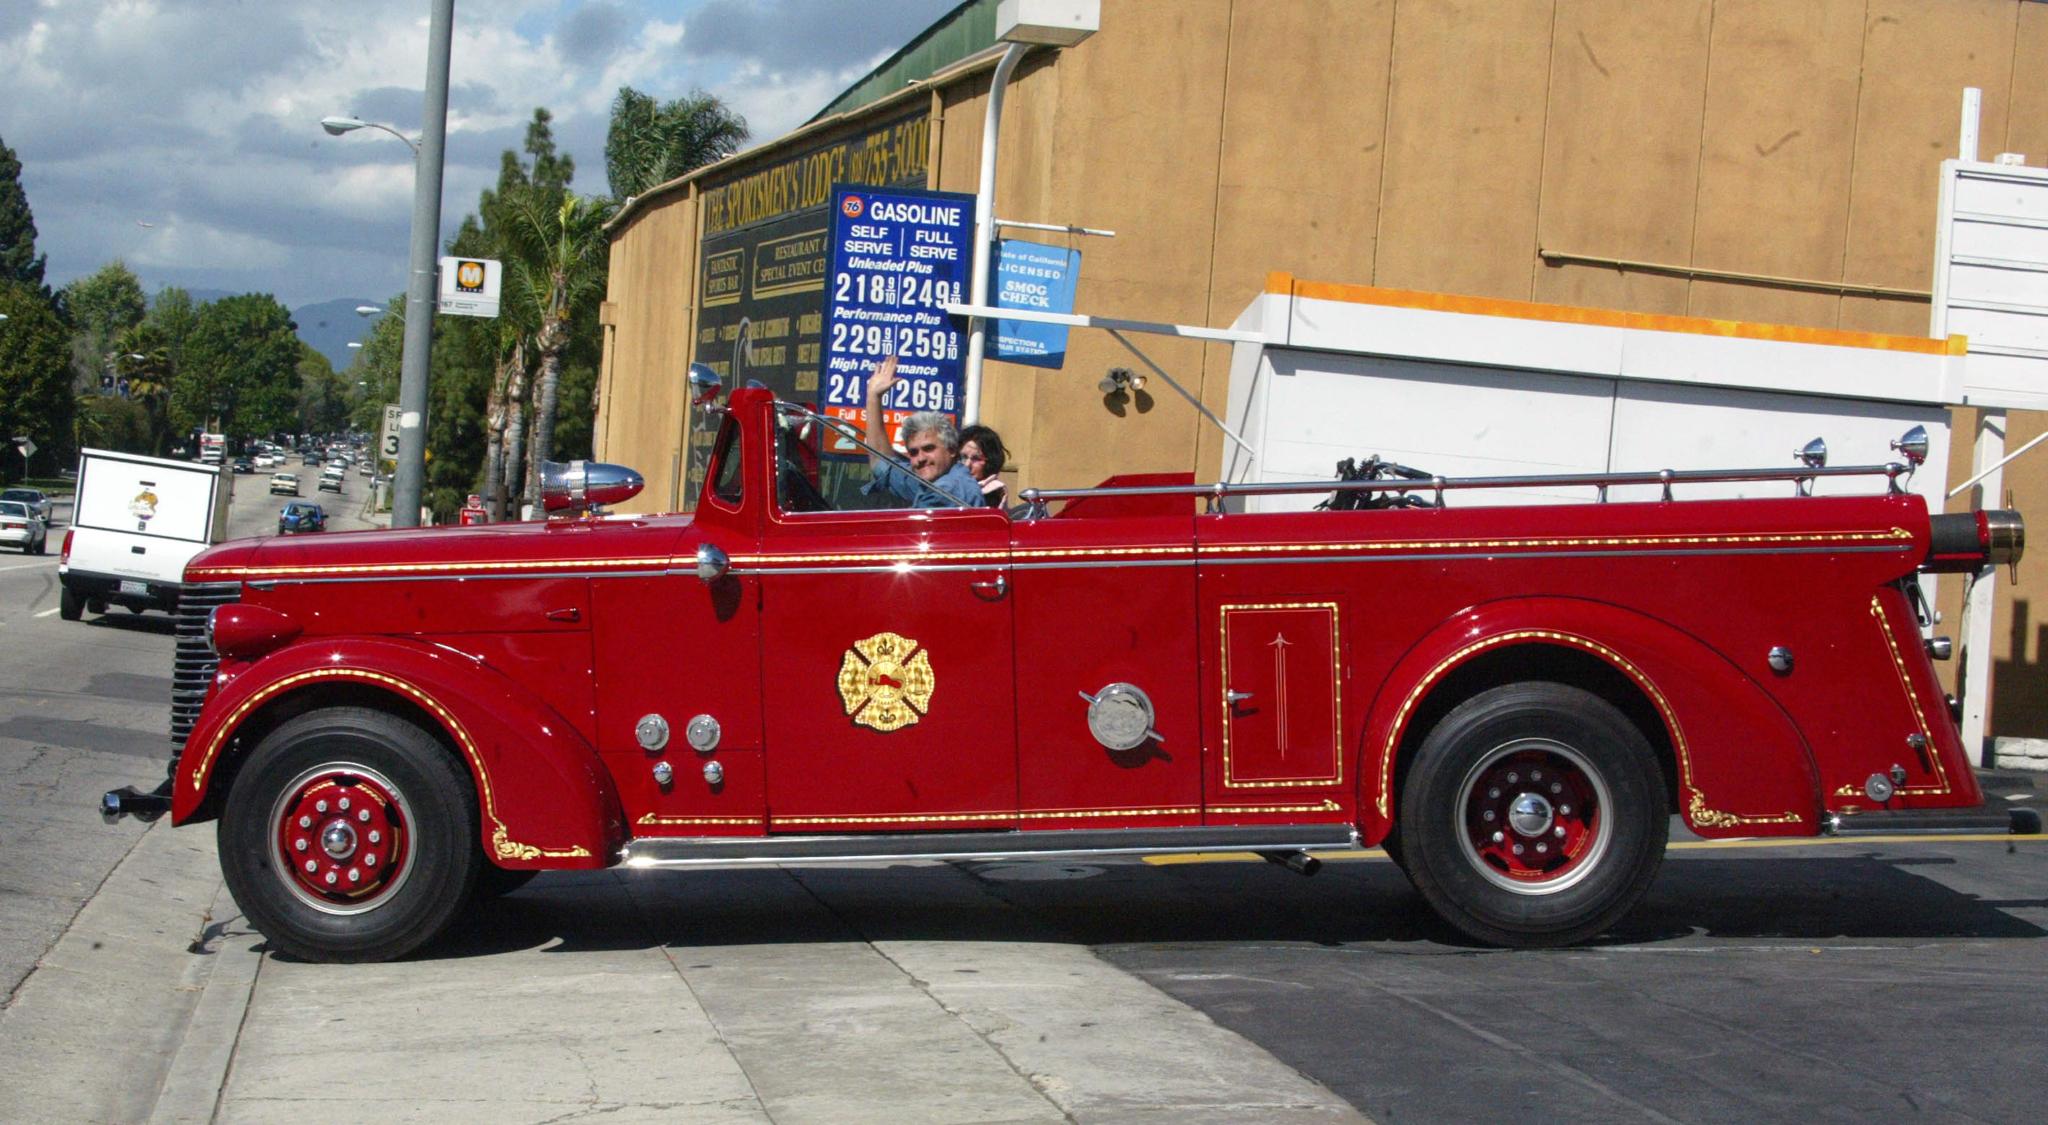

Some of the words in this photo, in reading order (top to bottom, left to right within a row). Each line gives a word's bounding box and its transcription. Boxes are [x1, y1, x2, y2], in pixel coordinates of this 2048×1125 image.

[726, 159, 799, 229] SPORTSMEN'S
[845, 201, 860, 212] 76
[870, 202, 960, 226] GASOLINE
[850, 225, 889, 239] SELF
[915, 230, 953, 244] FULL
[774, 239, 820, 261] RESTAURANT
[844, 240, 893, 255] SERVE
[910, 245, 958, 260] SERVE
[760, 264, 787, 281] SPECIAL
[788, 261, 812, 277] EVENT
[848, 257, 904, 272] Unleaded
[906, 261, 933, 274] Plus
[998, 262, 1061, 280] LICENSED
[463, 266, 481, 284] M
[835, 272, 885, 304] 218
[1005, 280, 1048, 296] SMOG
[1000, 291, 1050, 308] CHECK
[833, 306, 913, 323] Performance
[914, 312, 941, 325] Plus
[832, 323, 881, 355] 229
[898, 328, 947, 360] 259
[830, 357, 858, 373] High
[860, 359, 939, 376] Pemance
[828, 374, 869, 405] 24
[895, 379, 943, 410] 269
[839, 409, 856, 420] Full
